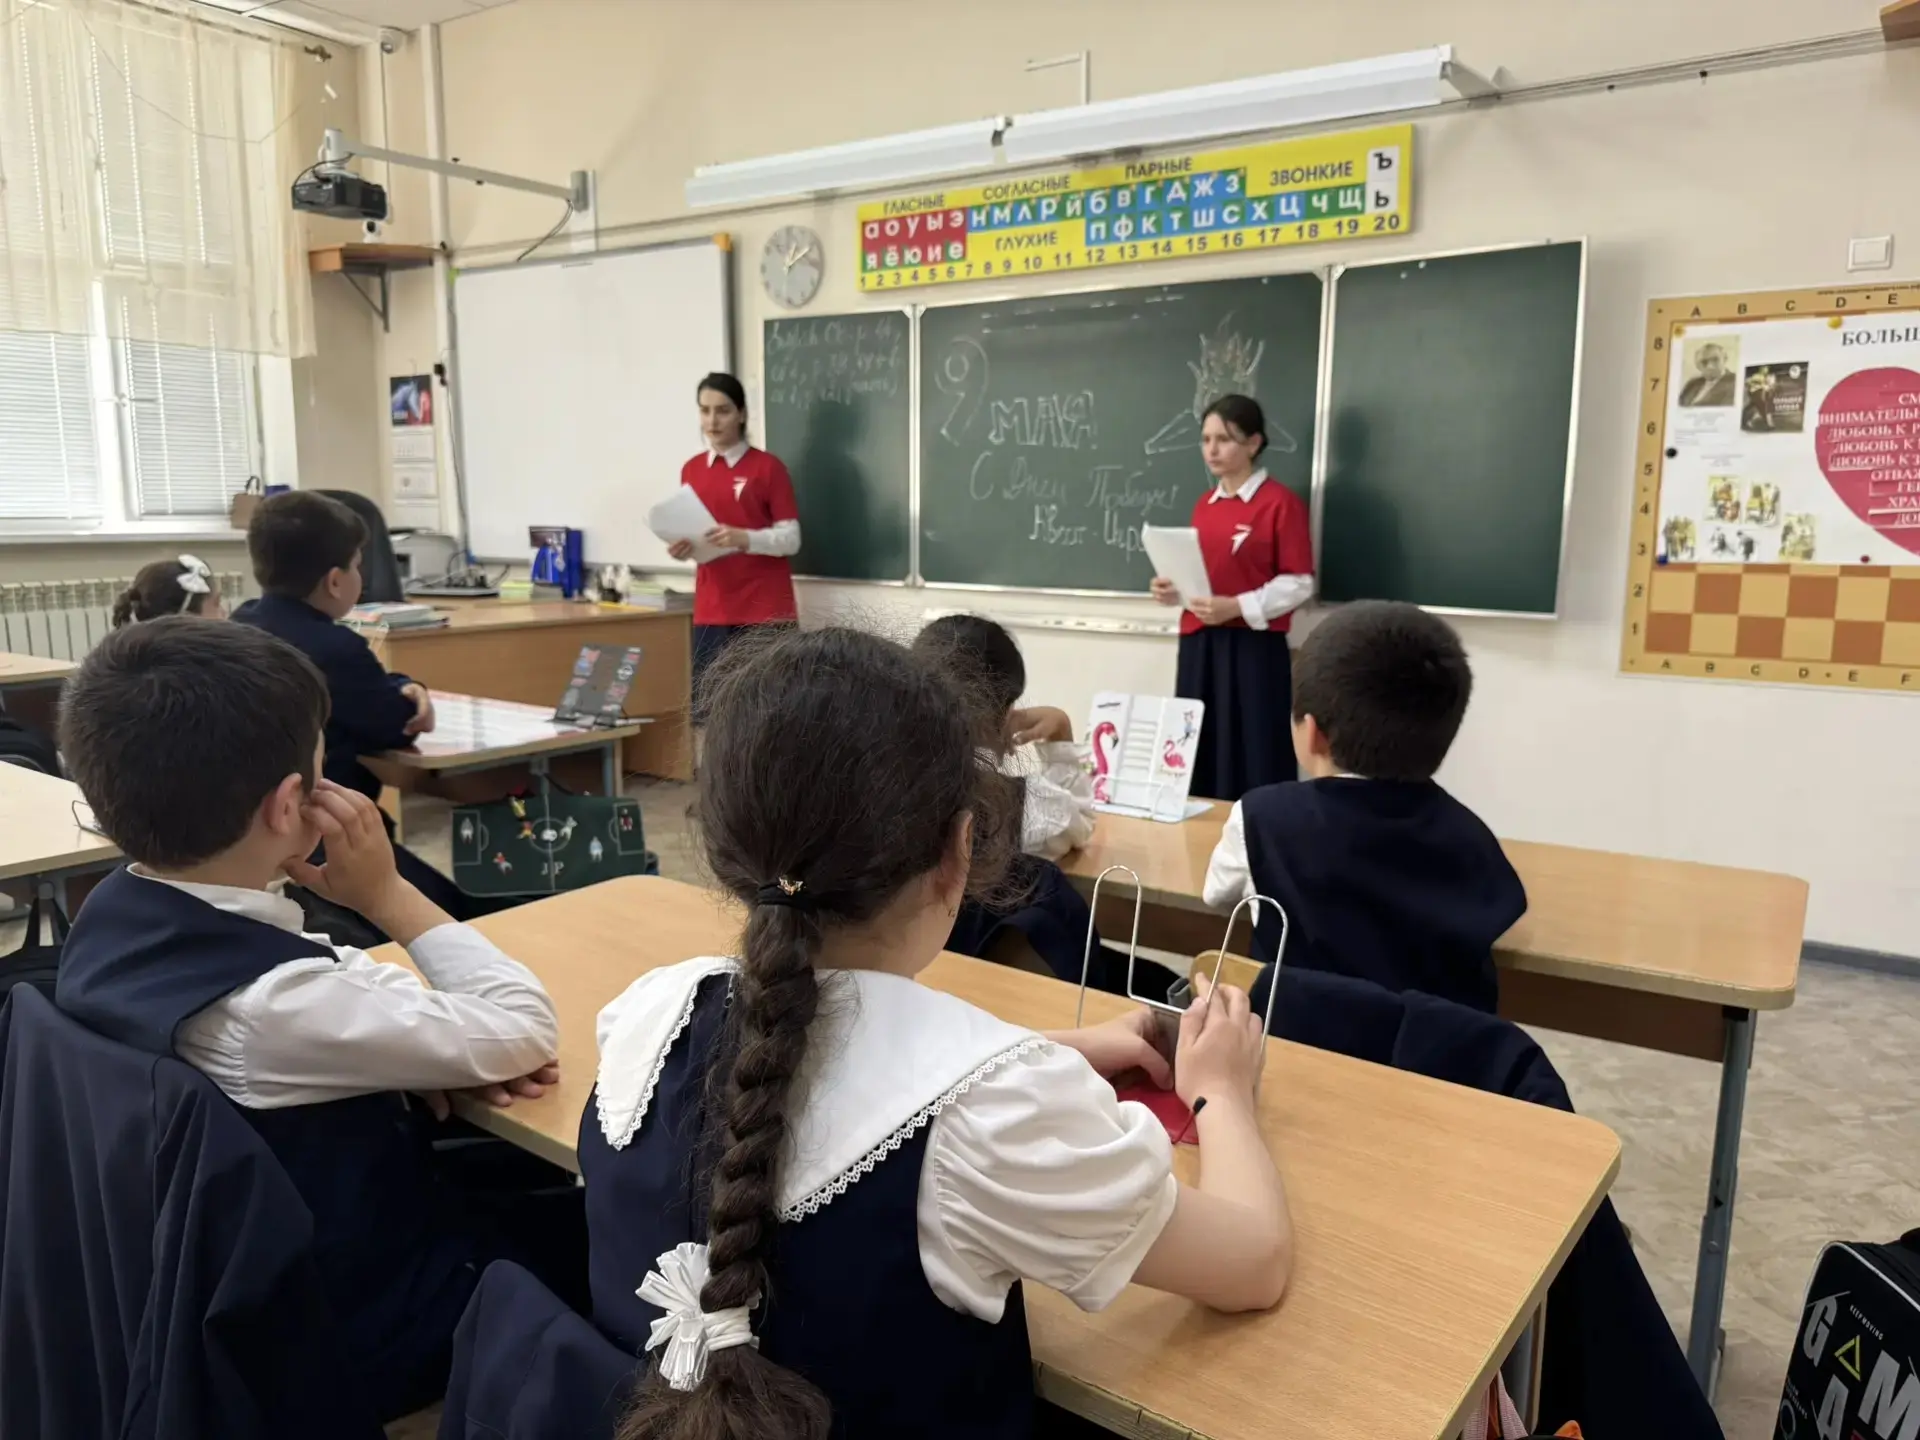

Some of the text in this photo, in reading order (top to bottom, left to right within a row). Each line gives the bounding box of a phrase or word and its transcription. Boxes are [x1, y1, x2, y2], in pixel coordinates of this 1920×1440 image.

[1125, 157, 1192, 179] ПАРНЫЕ
[1269, 160, 1353, 187] ЗВОНКИЕ
[983, 176, 1070, 200] СОГЛАСНЫЕ
[884, 195, 944, 215] ГЛАСНЫЕ
[861, 214, 1400, 288] 1 2 3 4 5 6 7 8 9 10 11 12 13 14 15 16 17 18 19 20
[995, 230, 1057, 251] ГЛУХИЕ
[1828, 424, 1891, 439] ЛЮБОВЬ
[1833, 439, 1898, 453] ЛЮБОВЬ
